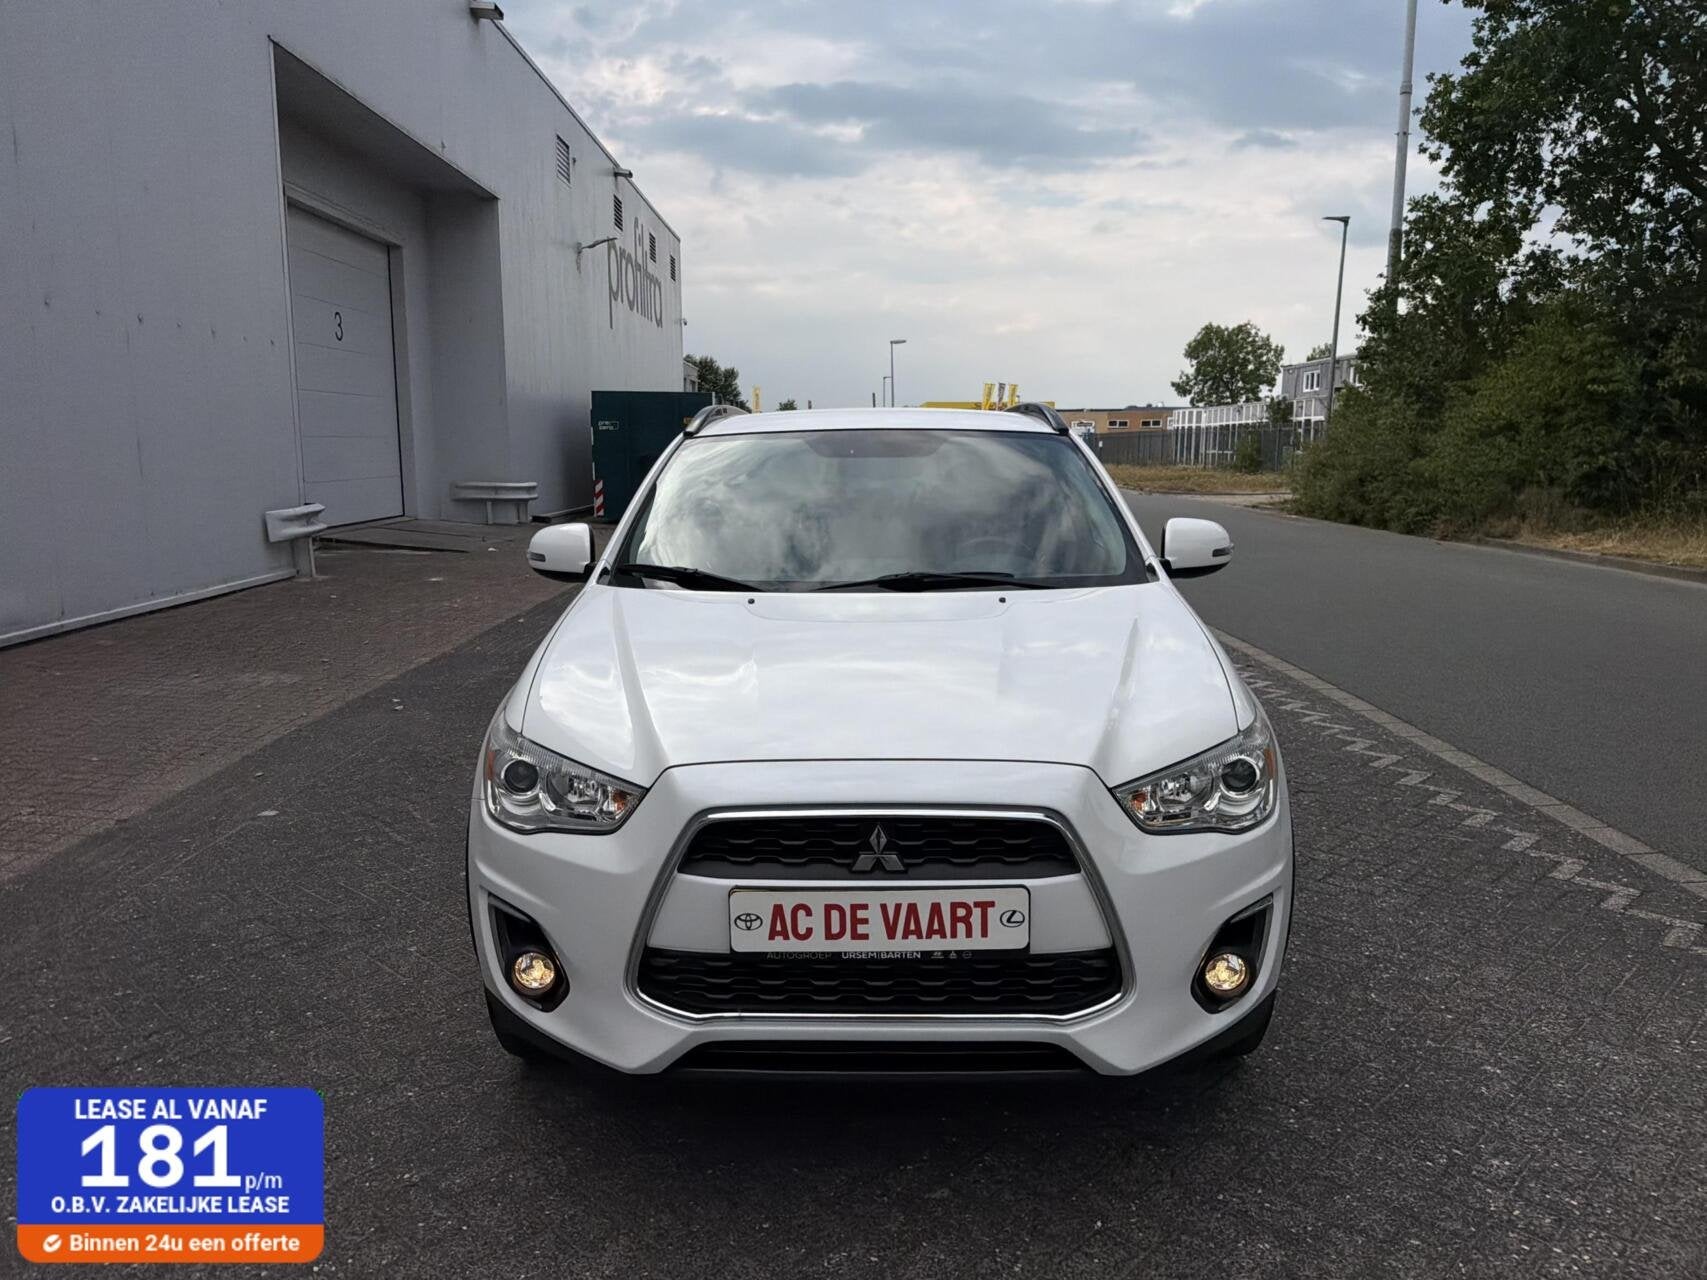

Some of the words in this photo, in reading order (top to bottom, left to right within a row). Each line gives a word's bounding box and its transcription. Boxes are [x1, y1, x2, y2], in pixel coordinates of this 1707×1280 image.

[334, 311, 344, 342] 3
[768, 904, 812, 940] AC
[824, 904, 869, 940] DE
[880, 901, 996, 938] VAART
